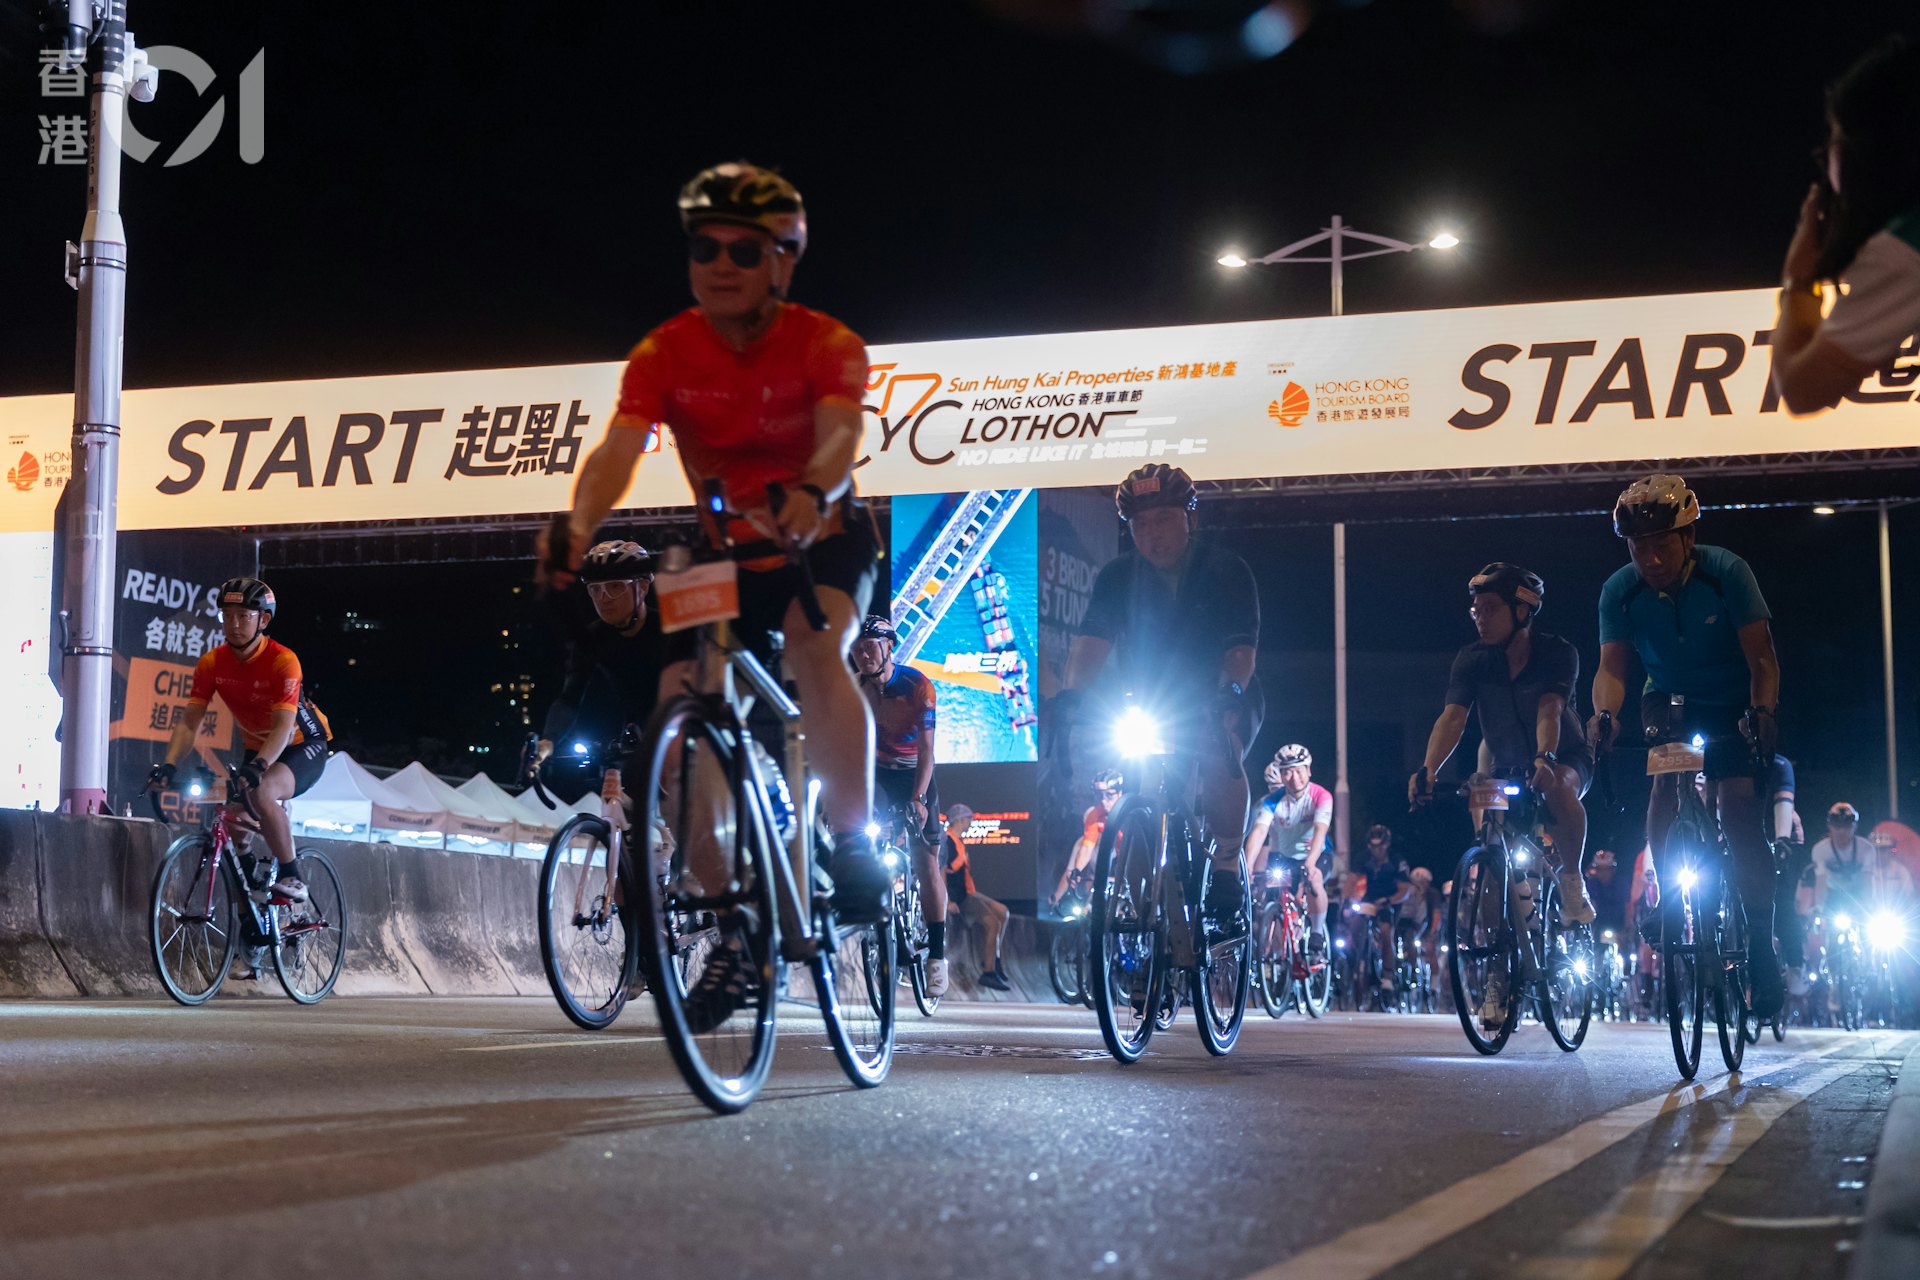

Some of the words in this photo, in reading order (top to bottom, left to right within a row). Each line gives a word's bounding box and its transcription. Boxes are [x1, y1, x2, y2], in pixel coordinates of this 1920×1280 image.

[947, 376, 981, 393] Sun
[984, 374, 1029, 394] Hung
[1033, 370, 1061, 387] Kai
[1064, 368, 1153, 388] Properties
[1157, 360, 1238, 381] 新鴻基地產
[1315, 380, 1361, 394] HONG
[1365, 377, 1410, 391] KONG
[1447, 330, 1780, 430] START
[972, 396, 1023, 412] HONG
[1026, 393, 1075, 409] KONG
[1078, 389, 1143, 406] 香港單車節
[1316, 395, 1365, 408] TOURISM
[1368, 393, 1410, 405] BOARD
[44, 451, 72, 463] HON
[155, 408, 444, 496] START
[444, 399, 591, 481] 起點
[957, 449, 988, 467] NO
[988, 447, 1030, 465] RIDE
[1029, 445, 1069, 462] LIKE
[1068, 444, 1088, 460] IT
[45, 465, 72, 474] TOURI
[1046, 546, 1057, 581] 3
[123, 568, 202, 617] READY,
[1041, 581, 1051, 616] 5
[1055, 586, 1090, 627] TUN
[154, 670, 193, 698] CHE
[1657, 754, 1693, 768] 2955
